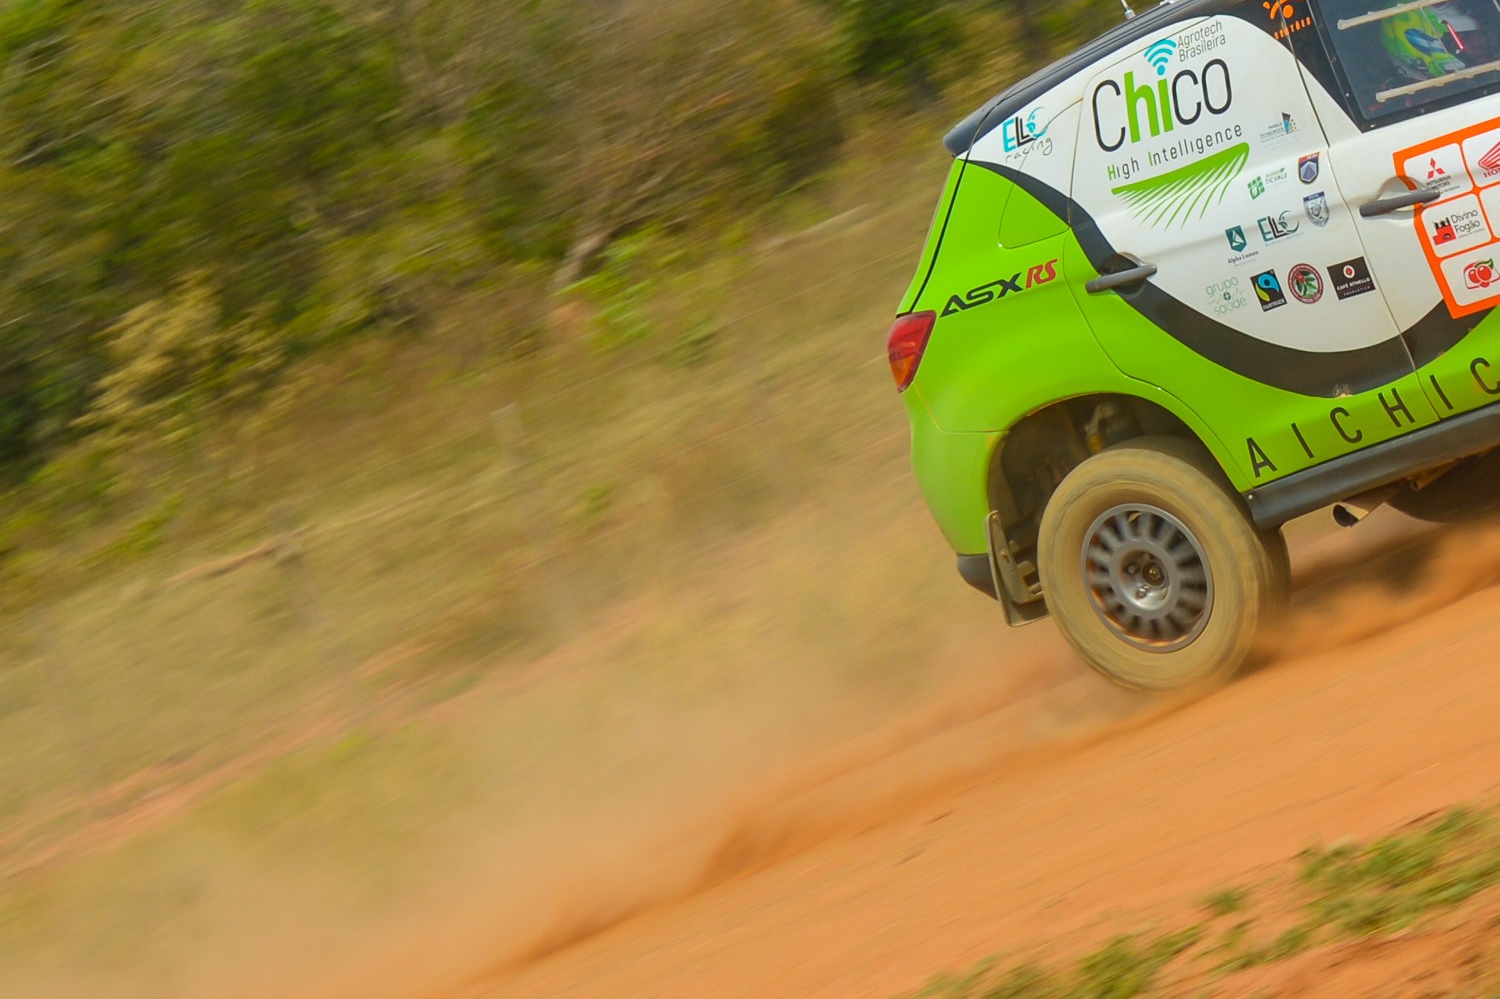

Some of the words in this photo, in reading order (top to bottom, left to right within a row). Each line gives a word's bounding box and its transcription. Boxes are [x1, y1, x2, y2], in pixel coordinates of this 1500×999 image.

[1178, 20, 1222, 49] Agrotech
[1179, 33, 1226, 62] Brasileira
[1092, 58, 1232, 152] Chico
[1005, 137, 1053, 162] racing
[1107, 157, 1140, 180] High
[1148, 124, 1243, 167] Intelligence
[1451, 209, 1478, 224] Divino
[1454, 220, 1480, 234] Fogão
[1228, 255, 1242, 265] Alpha
[940, 272, 1023, 317] ASX
[1206, 277, 1239, 298] grupo
